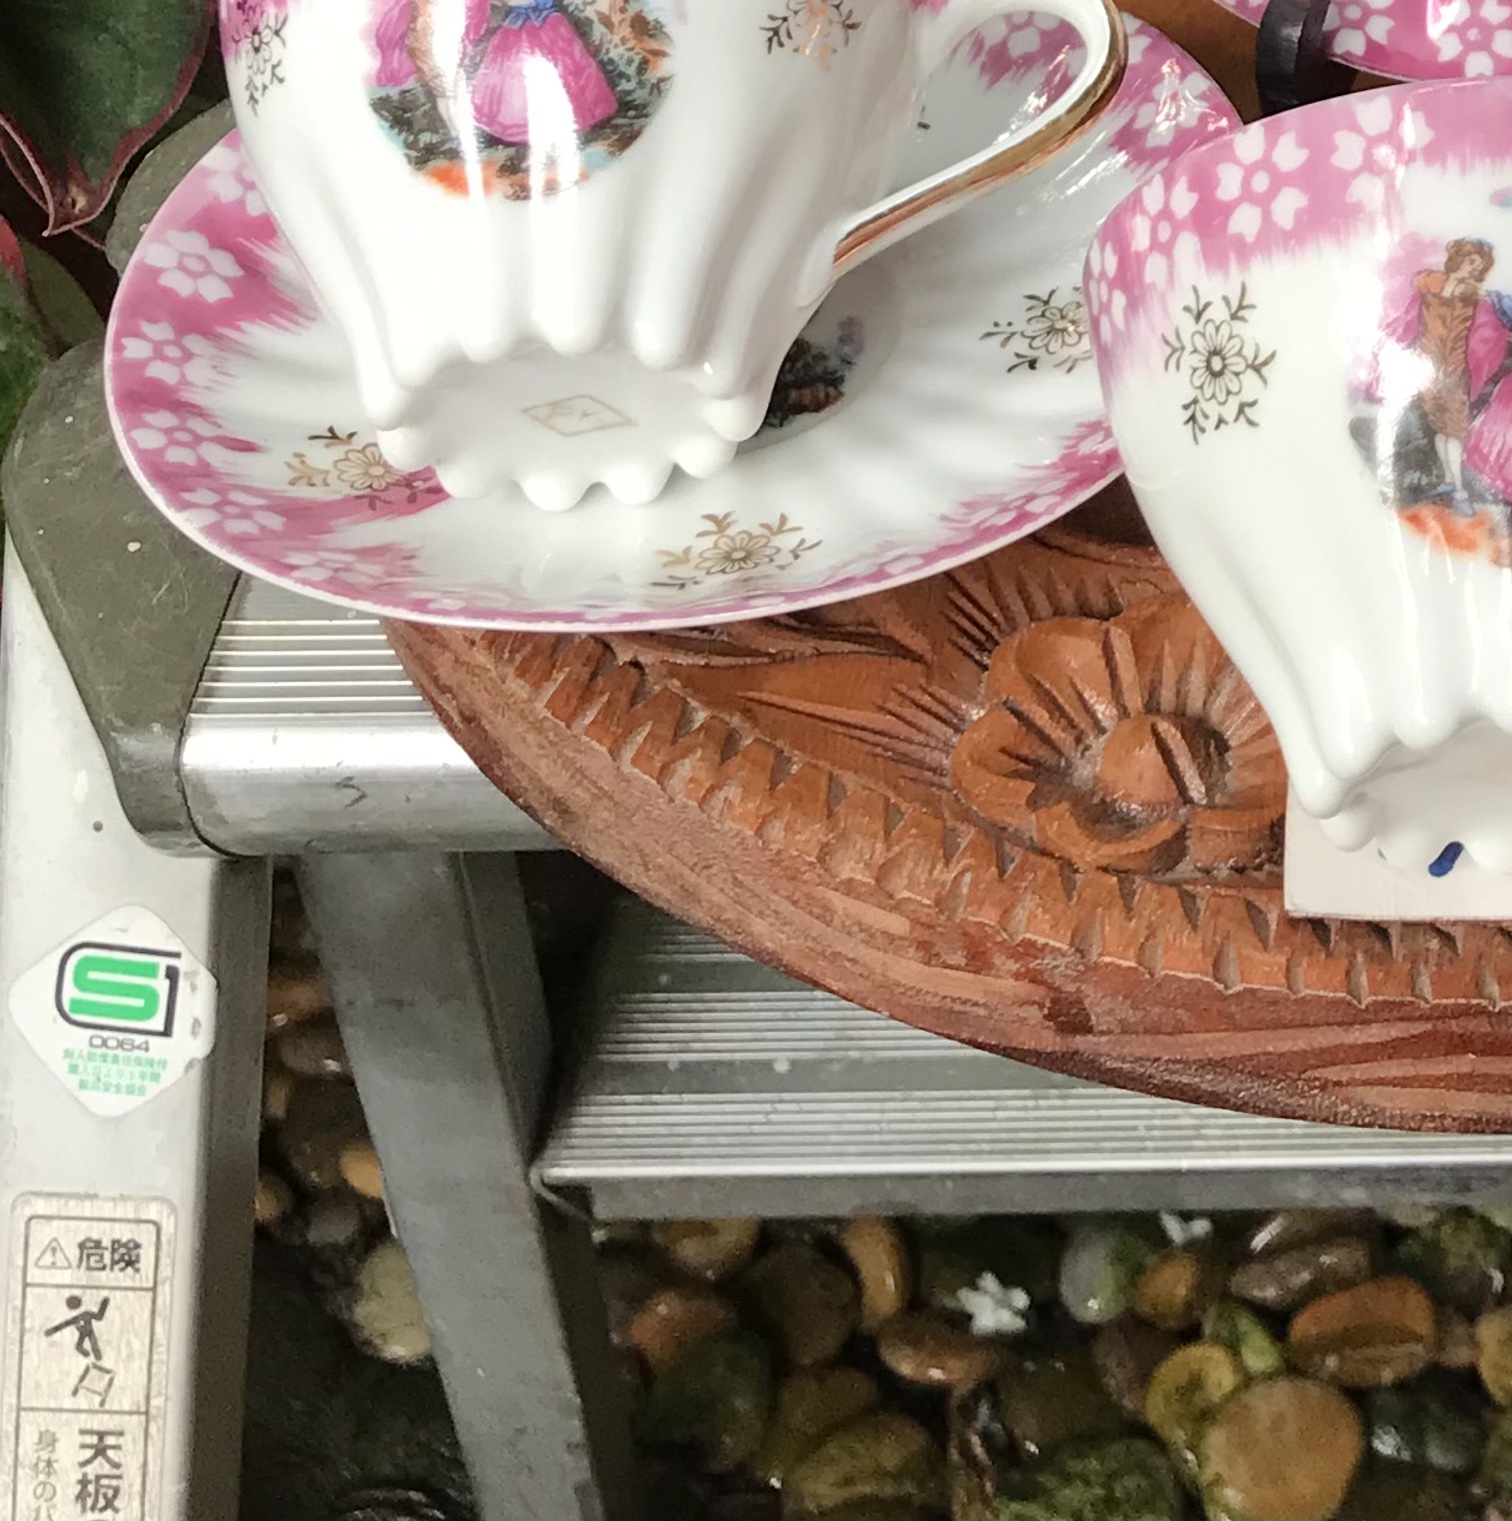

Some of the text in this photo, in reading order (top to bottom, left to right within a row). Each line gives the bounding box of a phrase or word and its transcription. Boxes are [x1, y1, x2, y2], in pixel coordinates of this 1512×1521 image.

[89, 1035, 150, 1052] 0064
[77, 1236, 142, 1272] 危険
[75, 1429, 125, 1521] 天板
